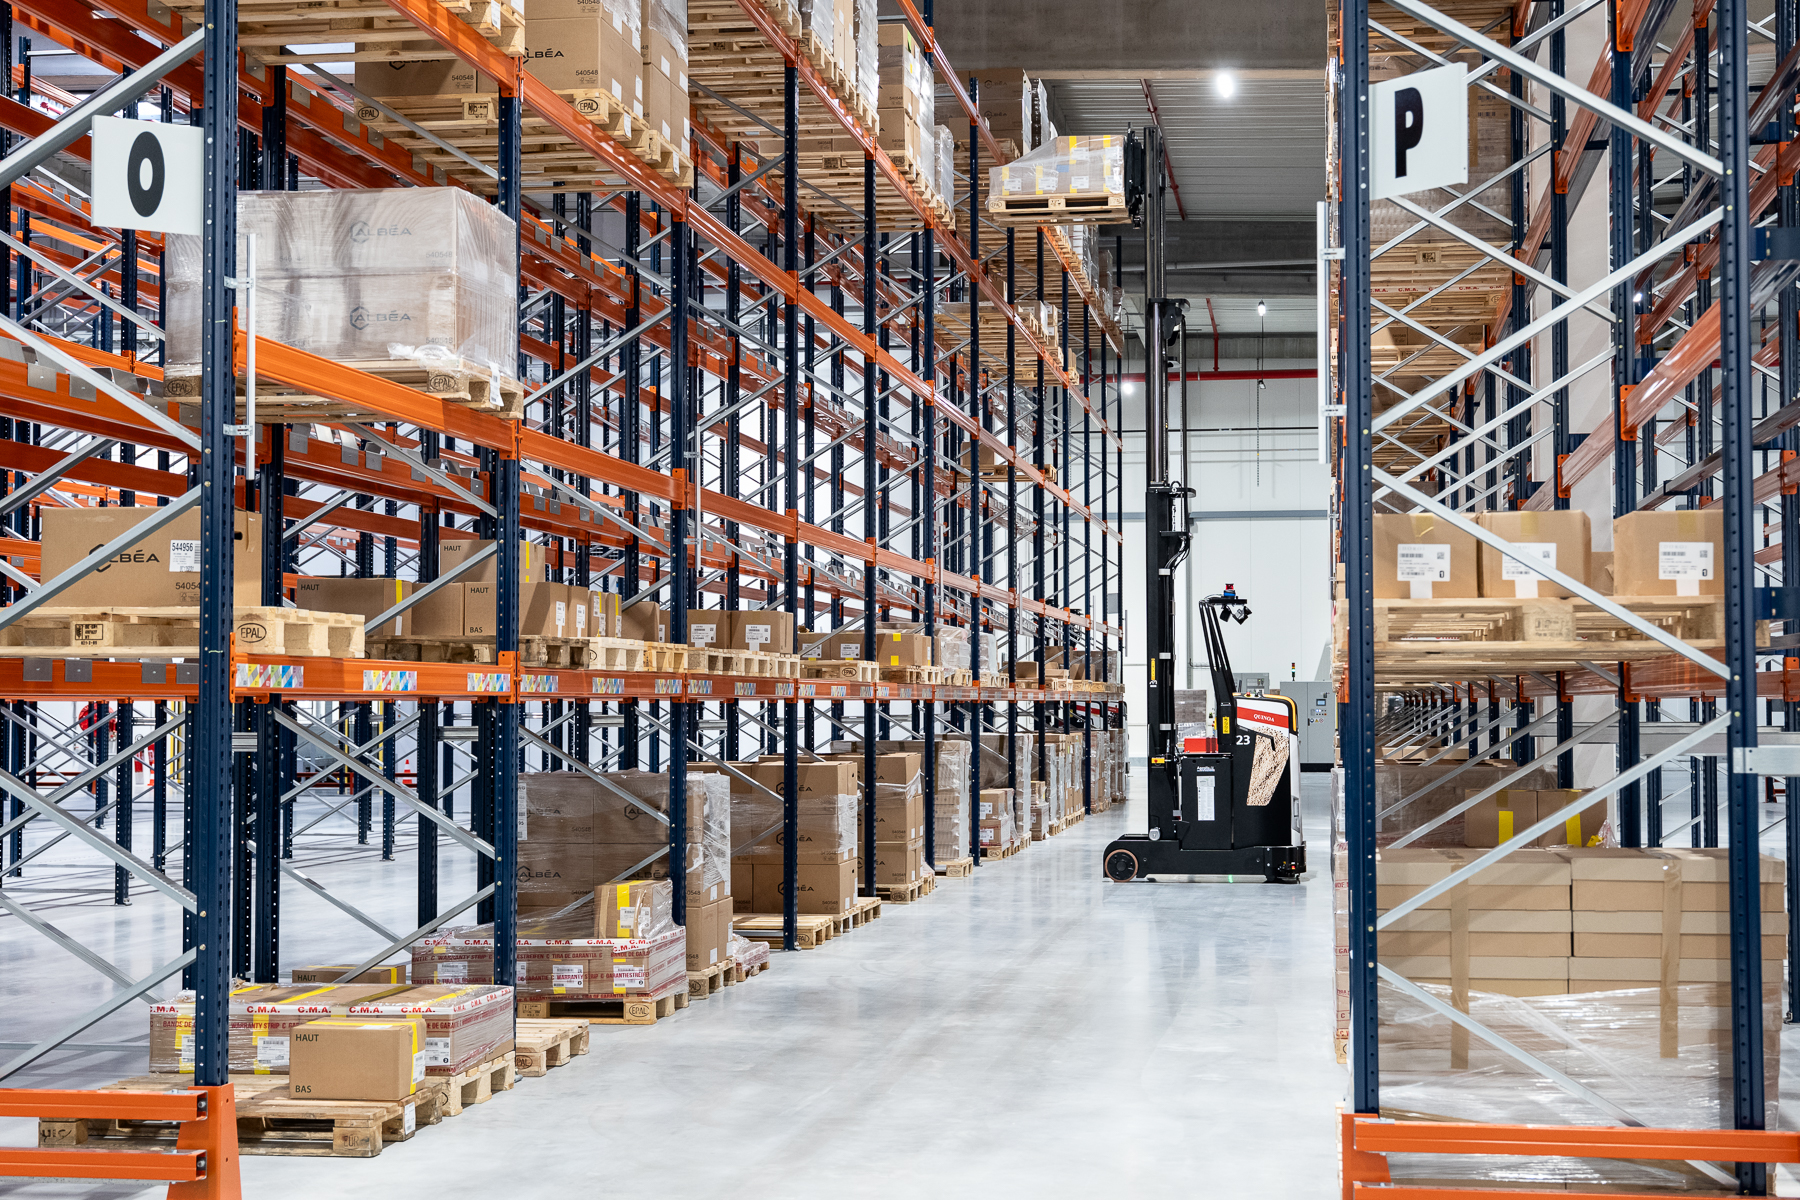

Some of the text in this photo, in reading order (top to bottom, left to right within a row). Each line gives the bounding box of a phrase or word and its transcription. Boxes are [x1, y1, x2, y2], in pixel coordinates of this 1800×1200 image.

[523, 48, 564, 58] LBÉA
[361, 108, 378, 119] EPAL
[1394, 87, 1424, 179] P
[127, 131, 165, 217] O
[354, 224, 412, 237] ALBÉA
[353, 310, 412, 322] ALBÉA
[172, 542, 194, 552] 544956
[108, 550, 160, 563] LBÉA
[241, 626, 262, 640] EPAL
[469, 626, 483, 634] BAS
[1253, 713, 1275, 723] QUINOA
[1236, 735, 1251, 746] 23
[518, 866, 562, 879] ALBÉA
[297, 974, 317, 982] HAUT
[246, 1005, 280, 1014] C.M.A.
[297, 1005, 332, 1014] C.M.A.
[349, 1006, 384, 1014] C.M.A.
[631, 1005, 647, 1015] EPAL
[295, 1034, 320, 1042] HAUT
[295, 1085, 312, 1094] BAS
